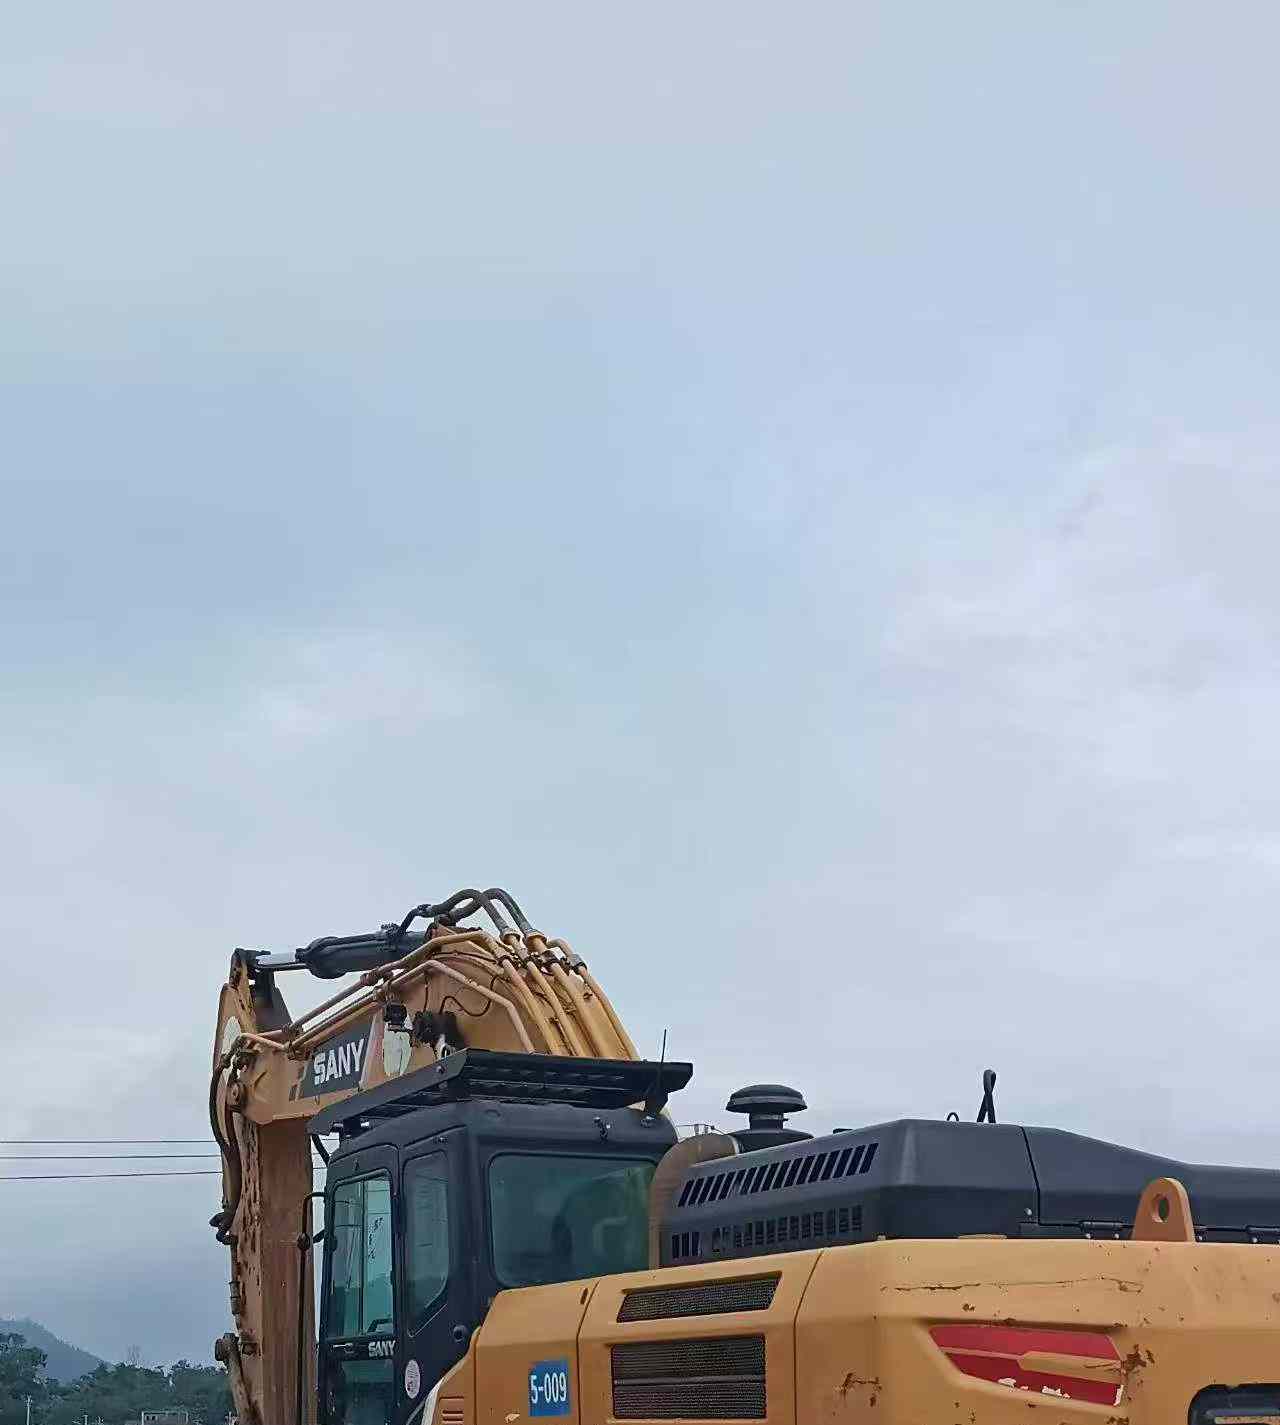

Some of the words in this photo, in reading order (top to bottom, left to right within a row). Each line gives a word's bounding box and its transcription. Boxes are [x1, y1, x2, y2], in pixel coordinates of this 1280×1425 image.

[313, 1038, 365, 1085] SANY
[368, 1340, 396, 1357] SANY
[530, 1372, 567, 1404] 5-009
